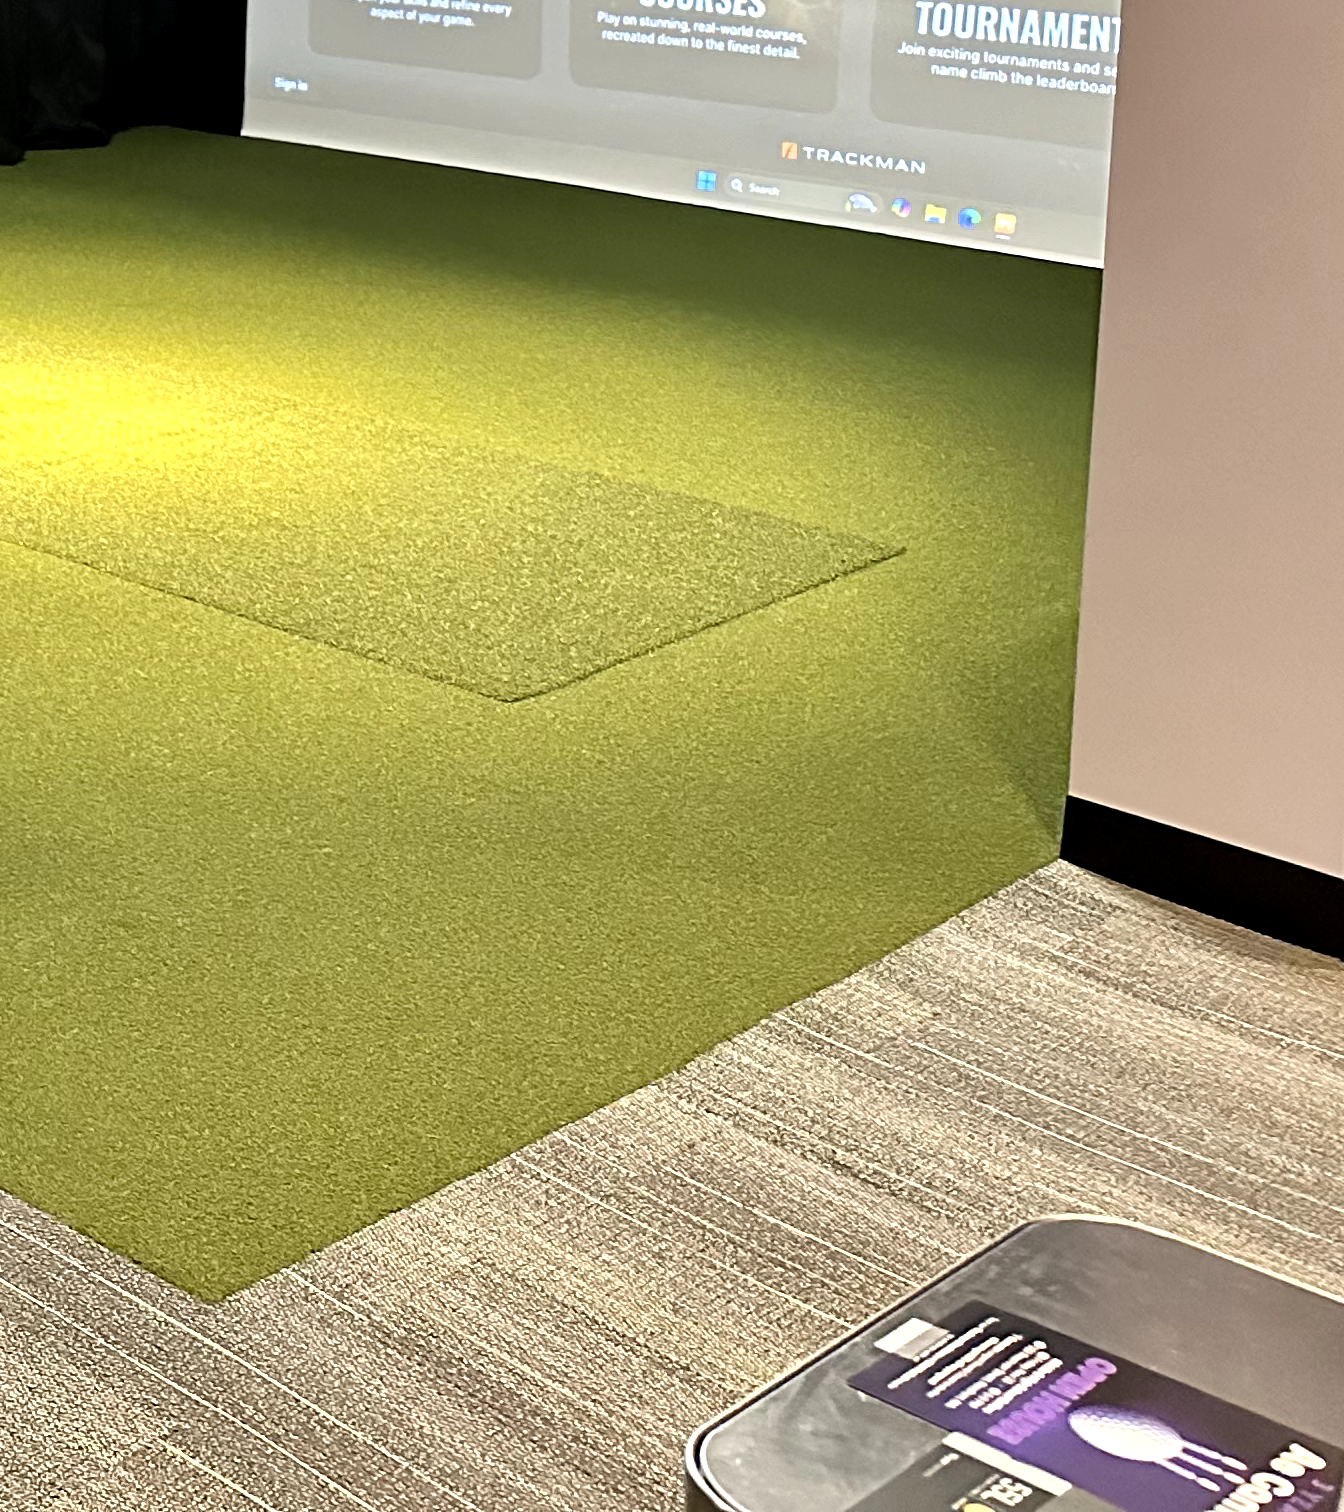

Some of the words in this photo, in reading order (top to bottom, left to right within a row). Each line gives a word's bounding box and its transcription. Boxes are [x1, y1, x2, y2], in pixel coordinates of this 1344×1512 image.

[370, 7, 404, 20] aspect
[405, 9, 417, 21] of
[418, 12, 441, 24] your
[442, 14, 476, 27] game.
[451, 0, 481, 12] refine
[482, 2, 512, 17] every
[596, 10, 621, 28] Play
[622, 15, 638, 27] on
[639, 16, 691, 34] stunning,
[693, 20, 753, 38] real-world
[755, 28, 807, 45] courses,
[601, 29, 655, 45] recreated
[657, 33, 689, 48] down
[690, 37, 703, 49] to
[705, 38, 725, 52] the
[727, 39, 761, 55] finest
[763, 44, 801, 60] detail.
[897, 41, 925, 57] Join
[928, 46, 981, 65] exciting
[983, 51, 1070, 72] tournaments
[1073, 62, 1100, 76] and
[274, 76, 297, 92] Sign
[297, 79, 309, 91] in
[930, 64, 968, 78] name
[970, 67, 1008, 84] climb
[1010, 71, 1033, 86] the
[802, 145, 926, 175] TRACKMAN
[749, 181, 781, 197] Search
[980, 1477, 1033, 1507] 55L
